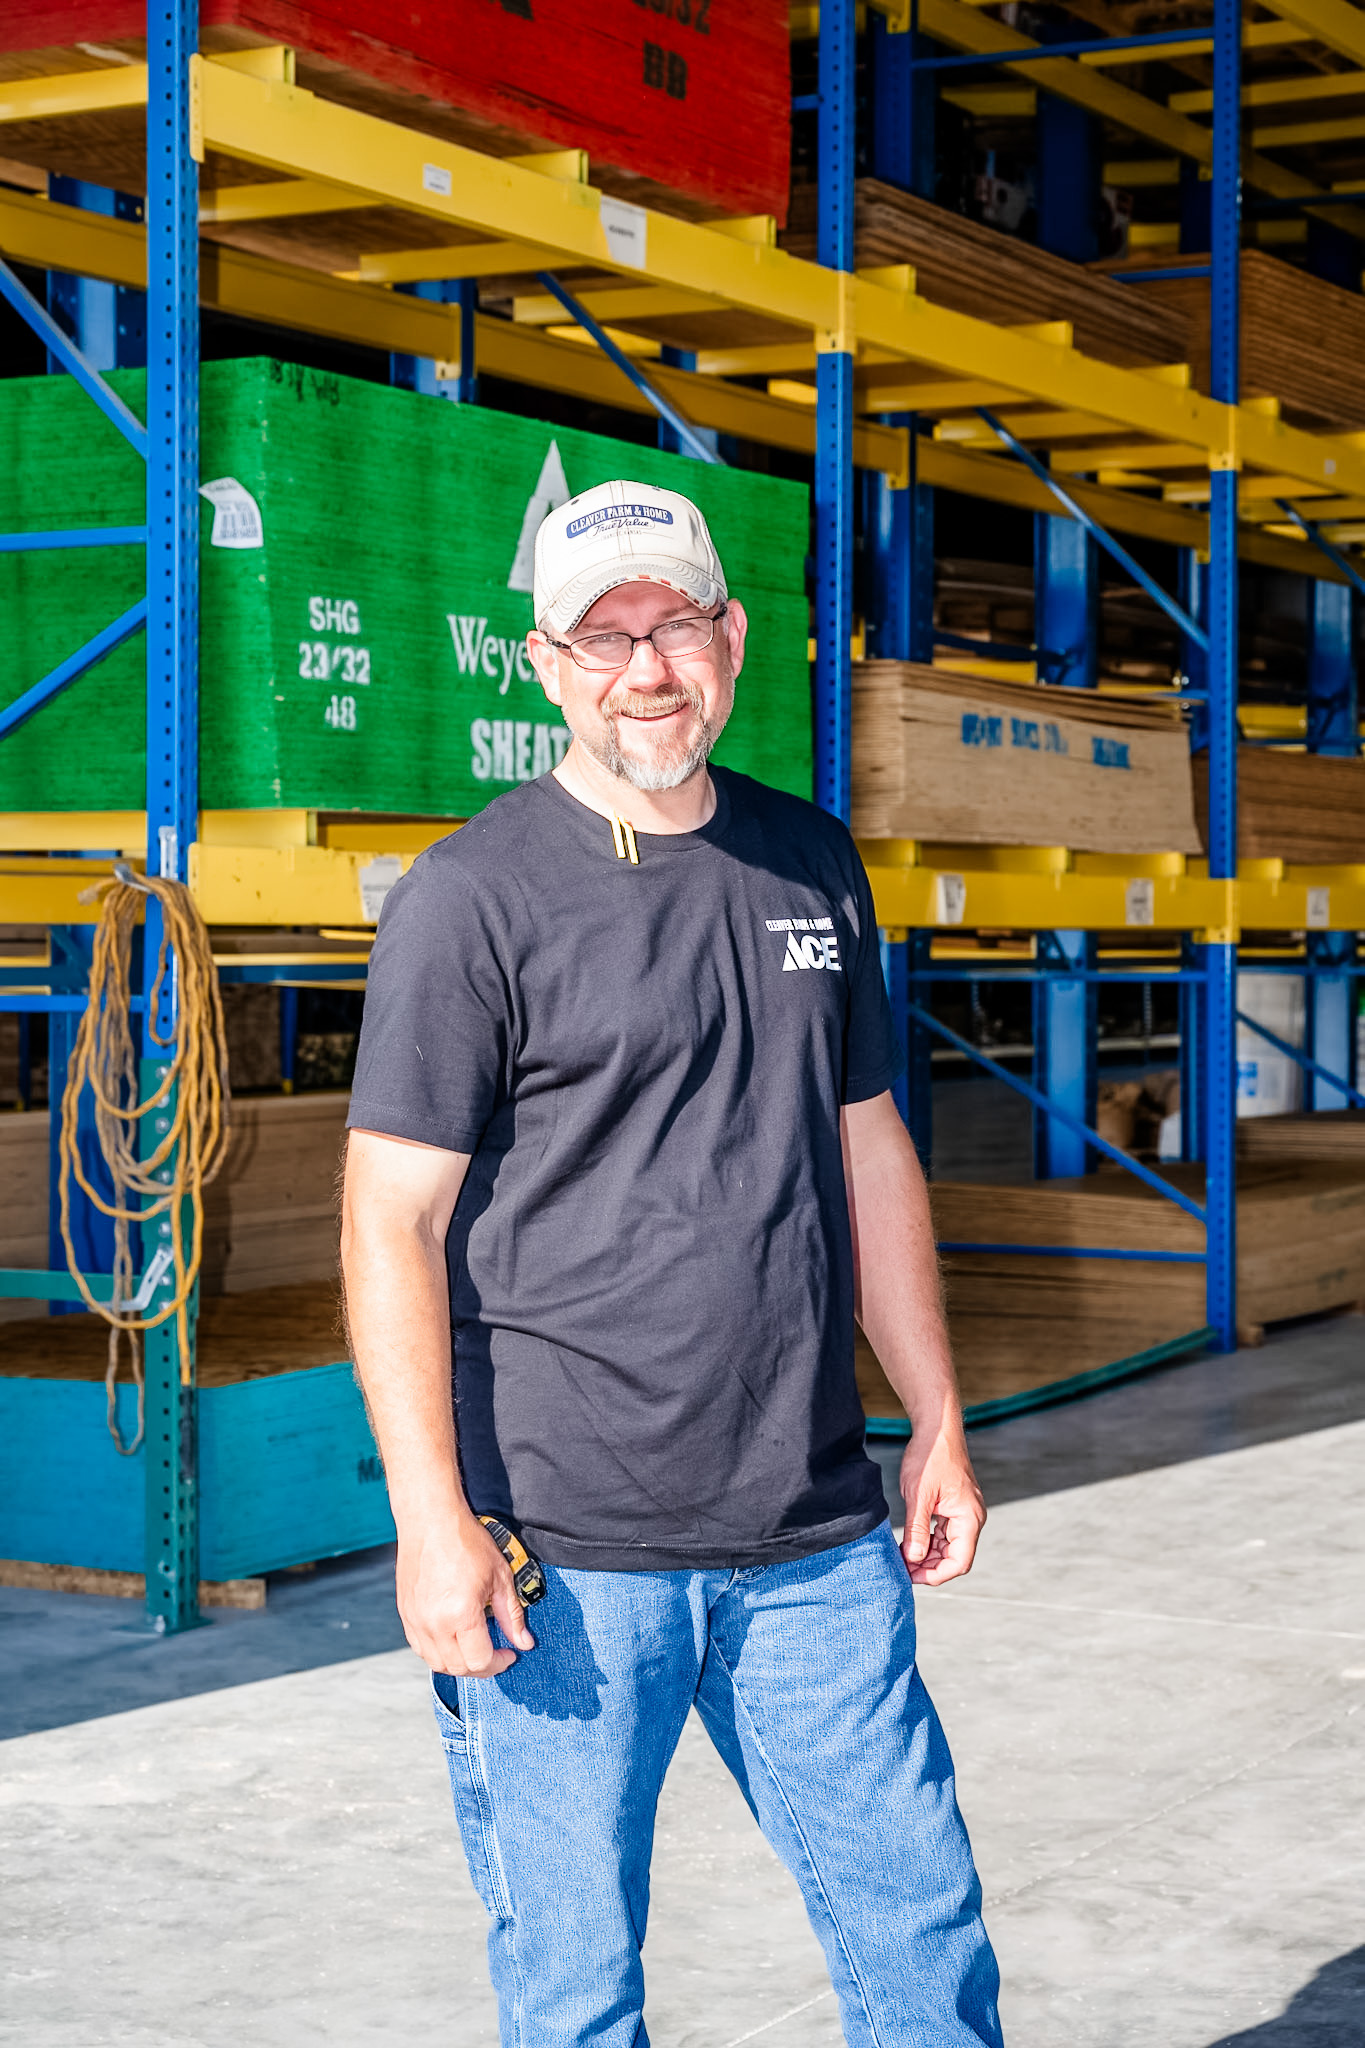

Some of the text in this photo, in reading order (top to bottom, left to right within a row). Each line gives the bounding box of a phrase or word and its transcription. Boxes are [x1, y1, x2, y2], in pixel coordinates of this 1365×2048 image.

[570, 505, 669, 534] CLEAVER FARM & HOME
[309, 596, 361, 635] SHG
[299, 641, 371, 686] 23/32
[446, 613, 541, 696] Weye
[782, 930, 843, 972] ACE
